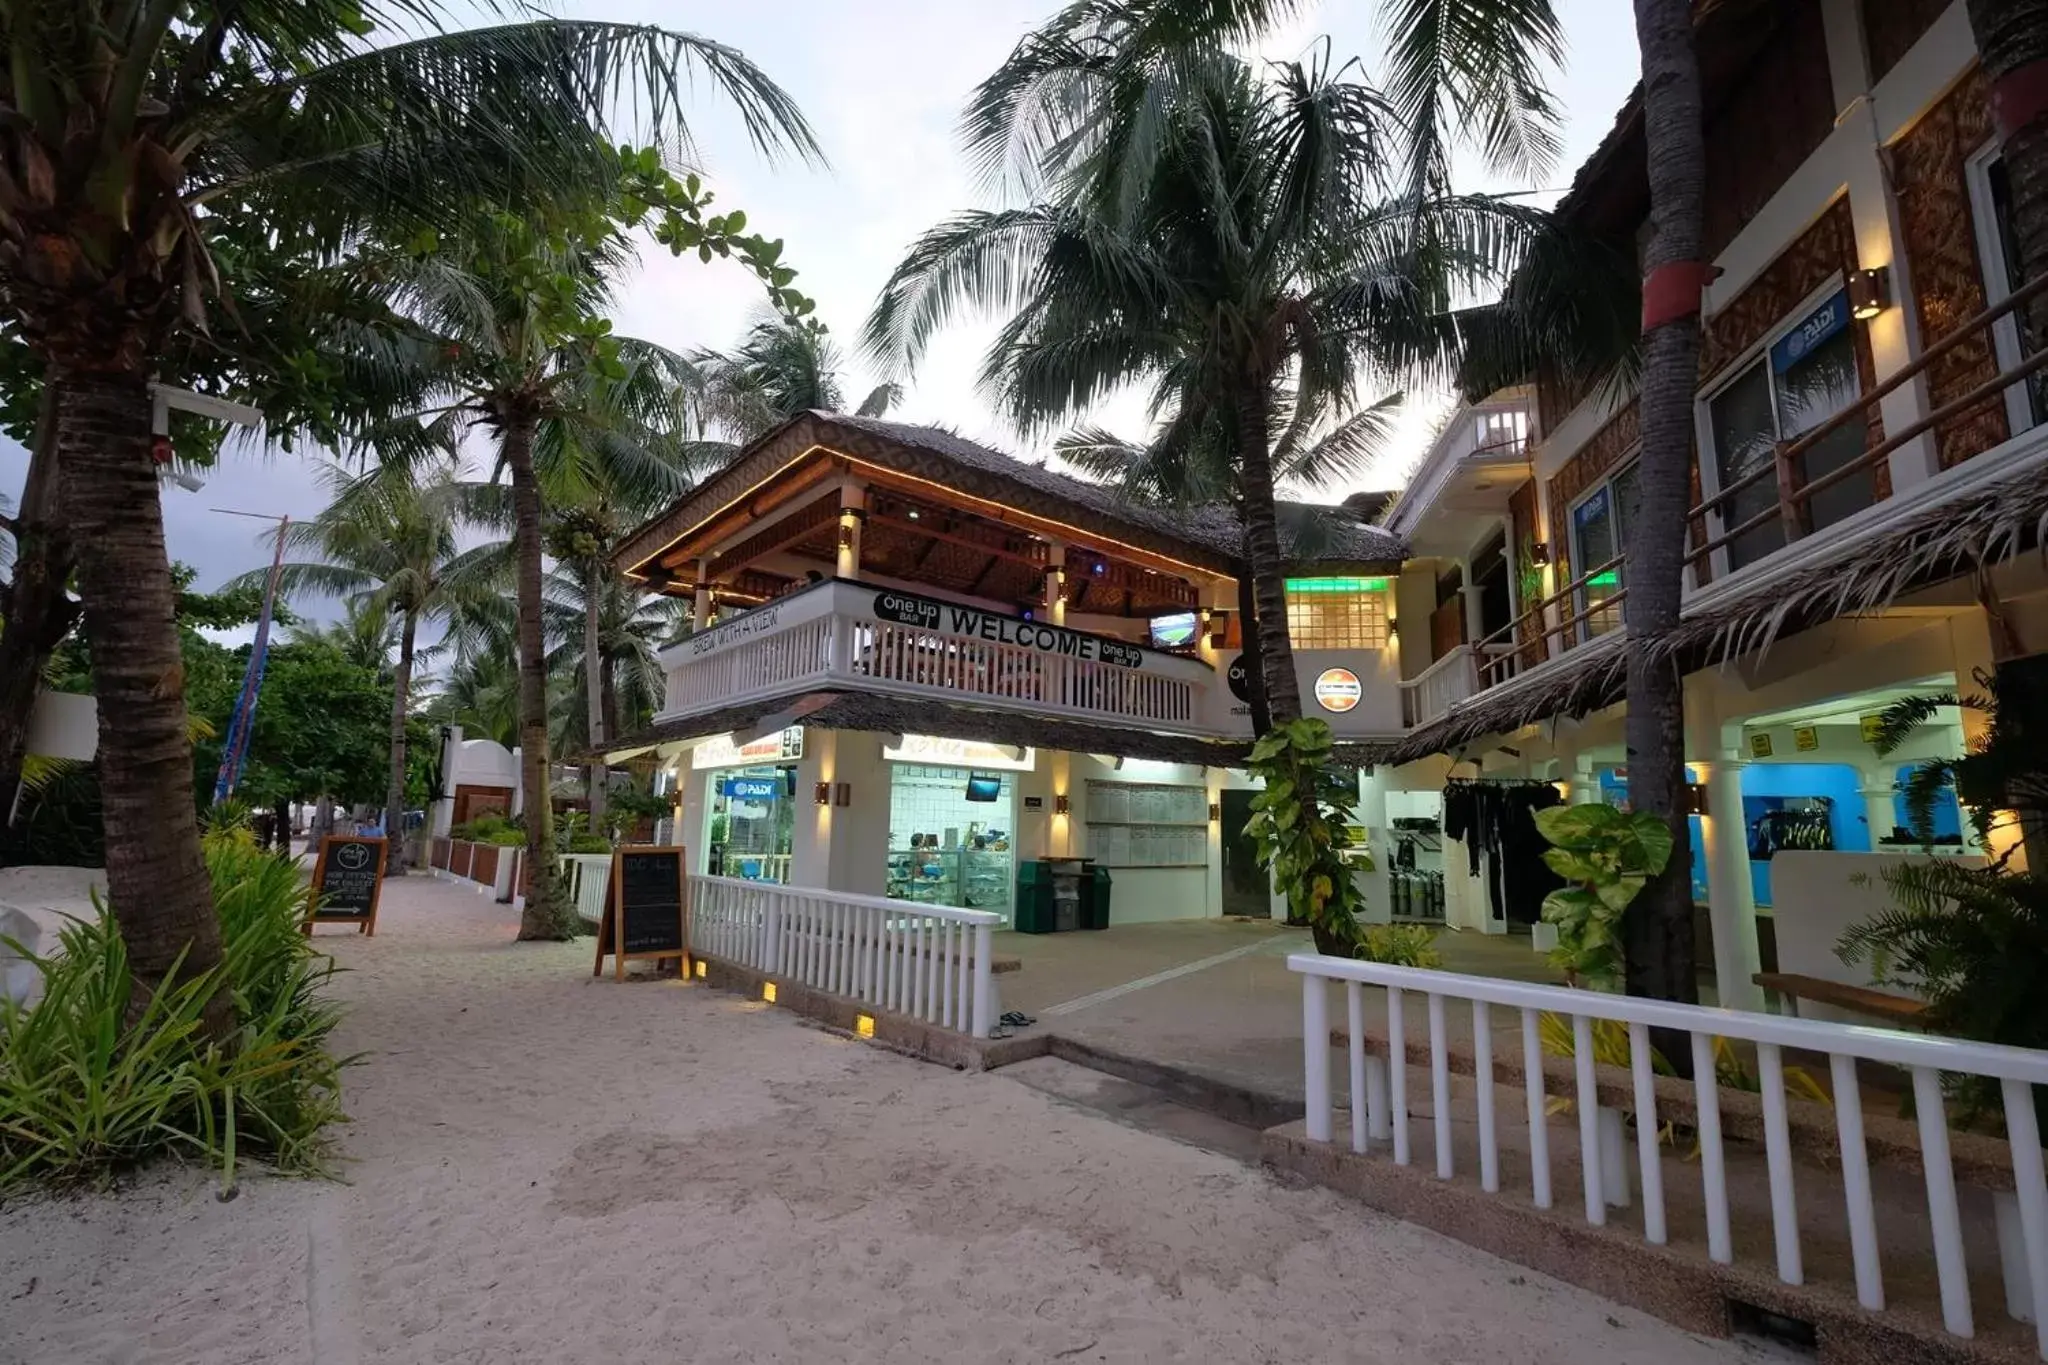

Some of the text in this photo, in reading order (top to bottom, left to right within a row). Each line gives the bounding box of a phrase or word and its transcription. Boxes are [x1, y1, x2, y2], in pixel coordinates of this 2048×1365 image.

[693, 607, 779, 655] BREW WITH A VIEW
[951, 608, 1093, 659] WELCOME
[747, 783, 772, 795] PADI
